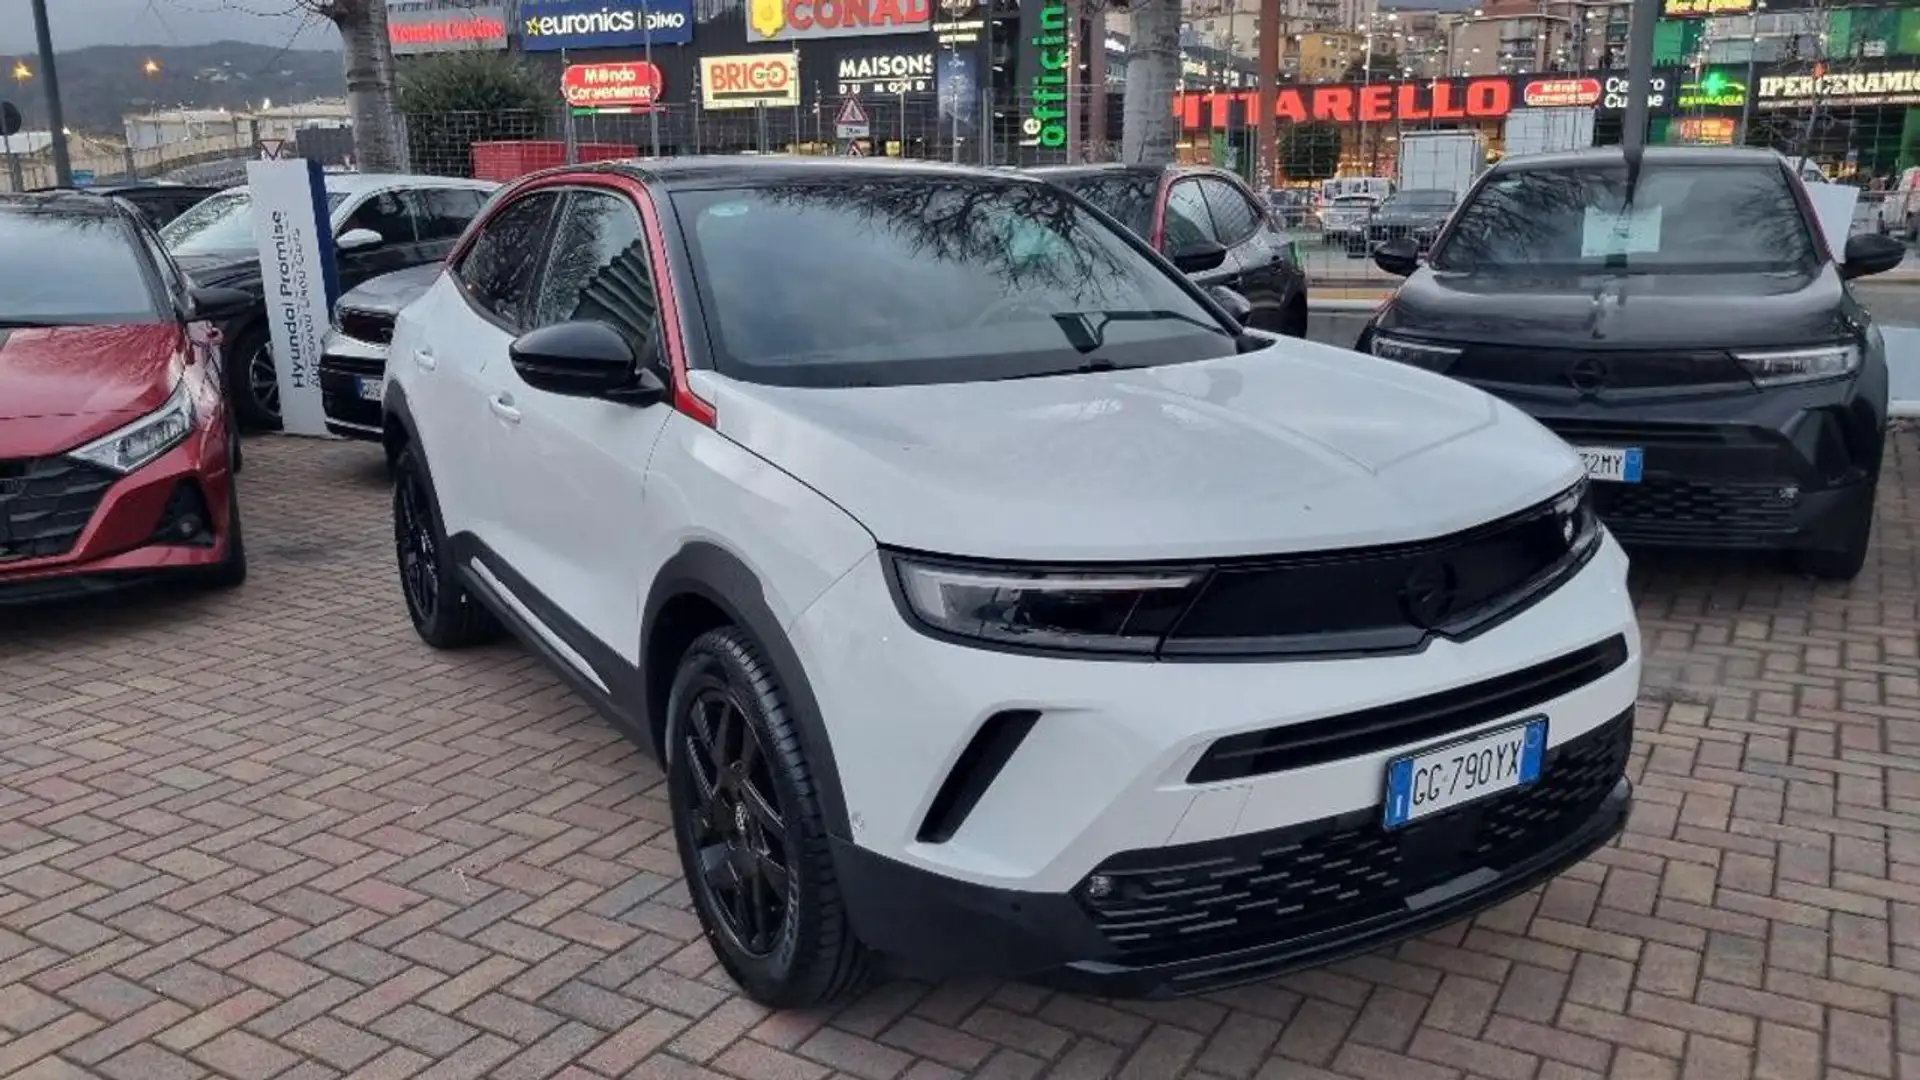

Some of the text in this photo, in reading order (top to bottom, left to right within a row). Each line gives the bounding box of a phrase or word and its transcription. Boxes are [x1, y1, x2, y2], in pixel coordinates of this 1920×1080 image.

[540, 7, 634, 35] euronics
[786, 0, 930, 29] CONAD
[710, 61, 788, 90] BRICO
[839, 80, 935, 95] DU MOND
[270, 210, 304, 389] Hyundai Promise
[1448, 739, 1522, 795] 790YX
